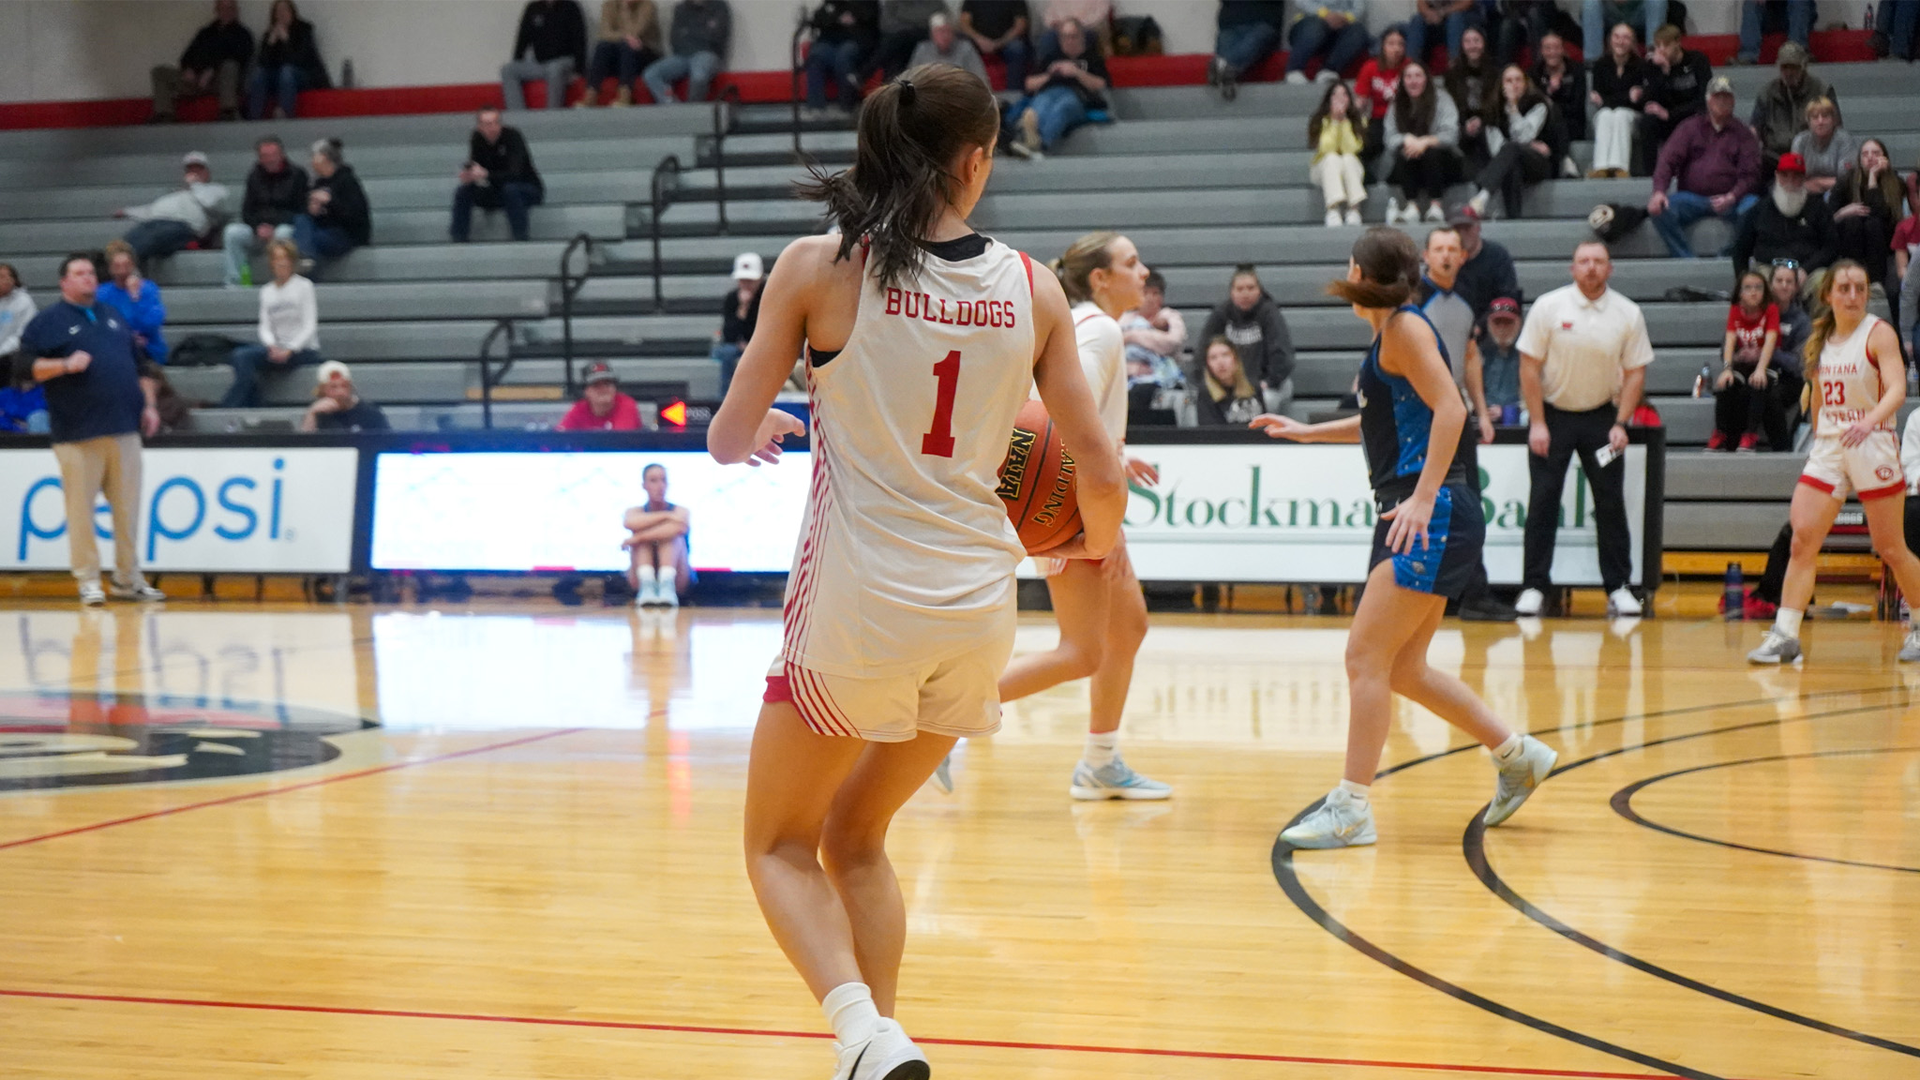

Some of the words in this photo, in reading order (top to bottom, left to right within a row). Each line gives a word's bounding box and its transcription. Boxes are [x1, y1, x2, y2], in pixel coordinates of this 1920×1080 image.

[885, 286, 1016, 329] BULLDOGS
[921, 349, 962, 459] 1
[1823, 380, 1846, 406] 23
[994, 428, 1037, 499] NAIA
[1032, 438, 1075, 527] ALDING
[1124, 463, 1377, 528] Stockma
